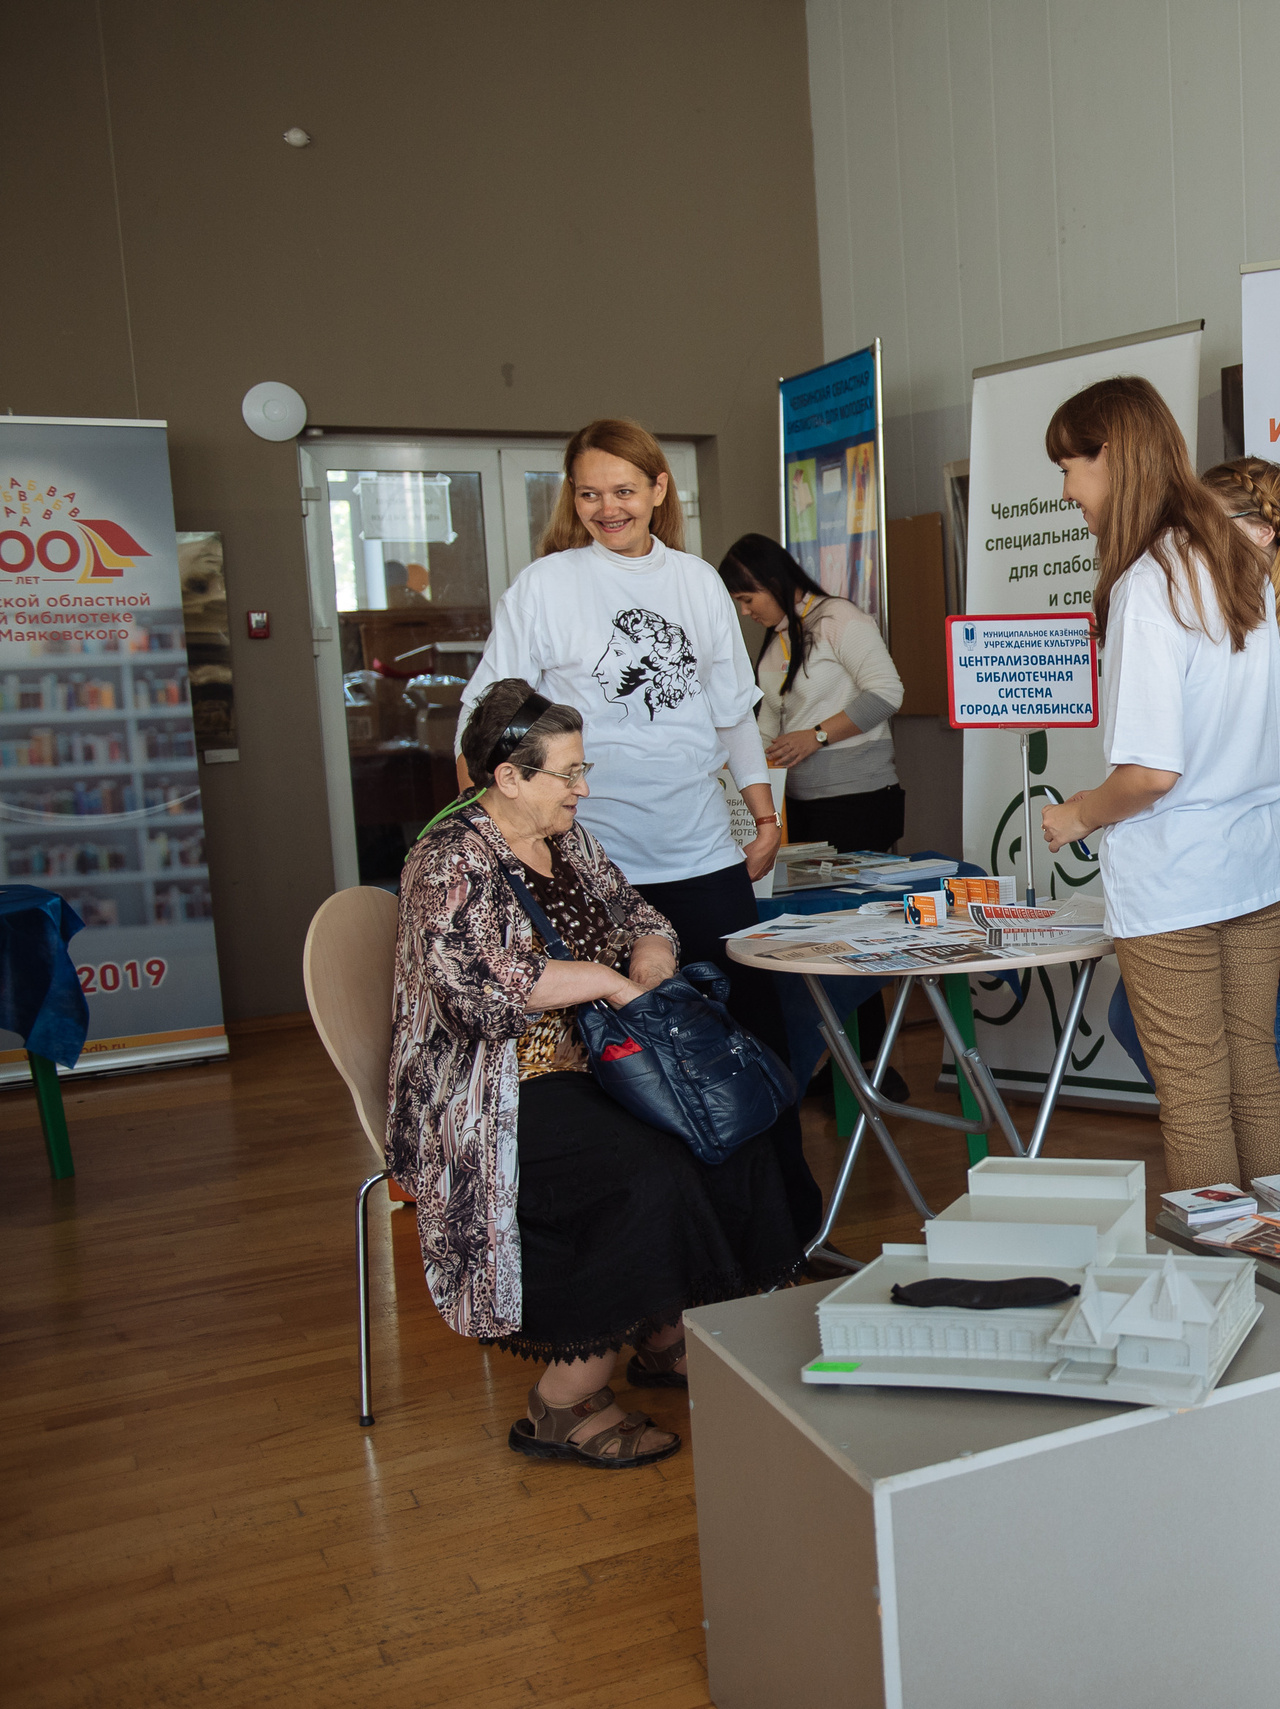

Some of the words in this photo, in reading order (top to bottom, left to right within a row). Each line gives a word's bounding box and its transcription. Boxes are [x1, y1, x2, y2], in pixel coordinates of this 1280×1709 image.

[985, 527, 1090, 552] специальная
[1009, 565, 1038, 582] для
[15, 577, 40, 585] ЛЕТ
[46, 593, 151, 607] областной
[1049, 593, 1058, 607] и
[15, 612, 133, 625] библиотеке
[0, 629, 129, 642] Маяковского
[983, 630, 1048, 638] МУНИЦИПАЛЬНОЕ
[1050, 628, 1088, 637] КАЗЁННОЕ
[984, 640, 1042, 649] УЧРЕЖДЕНИЕ
[1044, 638, 1088, 648] КУЛЬТУРЫ
[959, 654, 1089, 668] ЦЕНТРАЛИЗОВАННАЯ
[976, 671, 1073, 682] БИБЛИОТЕЧНАЯ
[998, 688, 1053, 699] СИСТЕМА
[960, 704, 1008, 716] ГОРОДА
[1012, 703, 1093, 715] ЧЕЛЯБИНСКА
[77, 959, 166, 993] 2019
